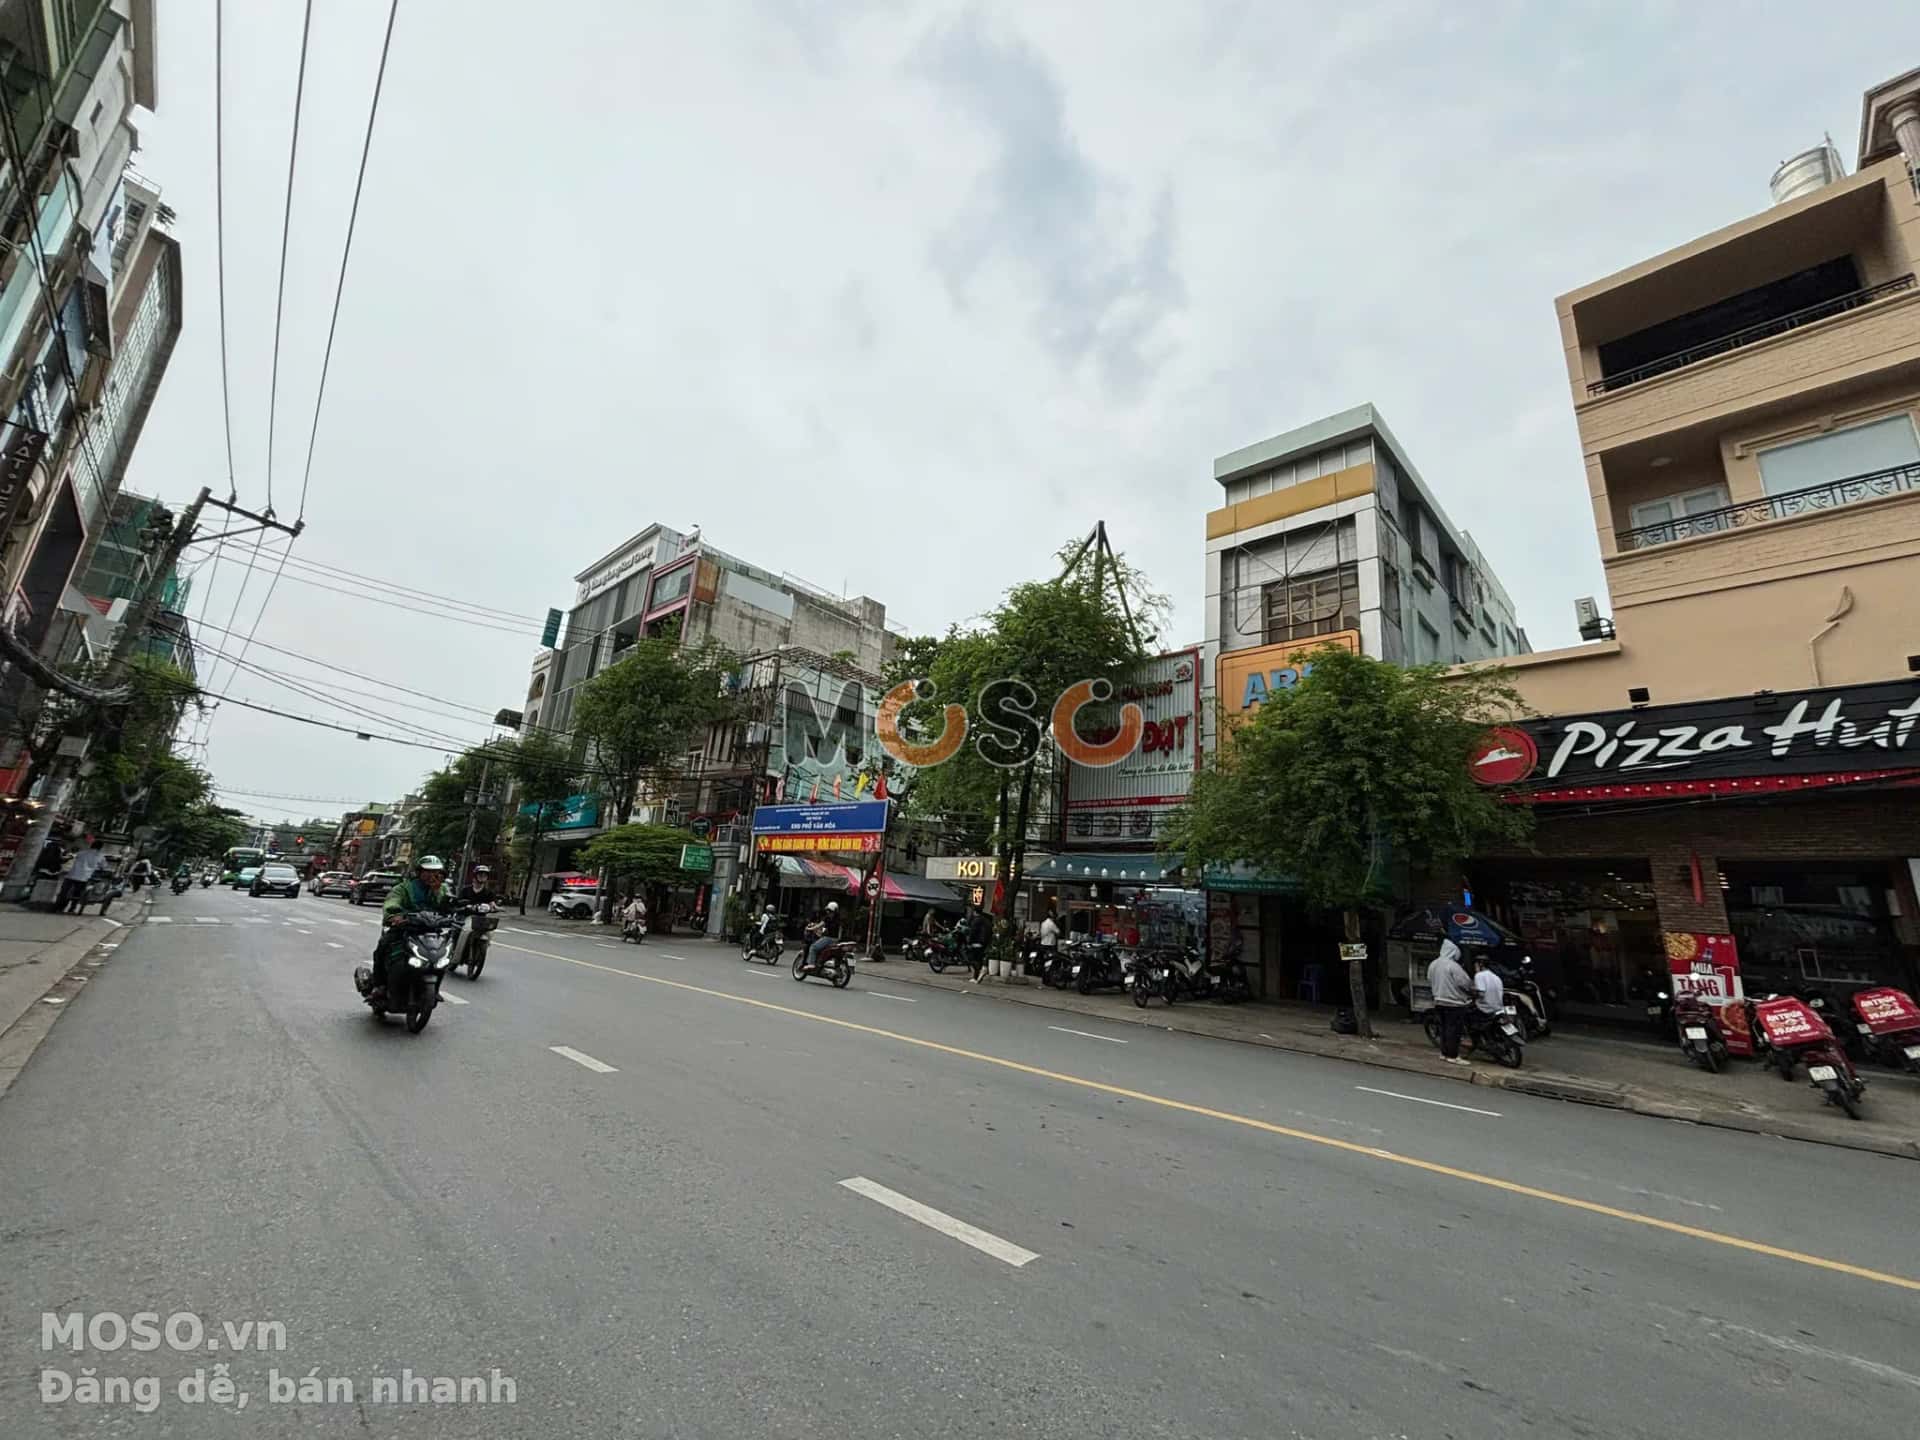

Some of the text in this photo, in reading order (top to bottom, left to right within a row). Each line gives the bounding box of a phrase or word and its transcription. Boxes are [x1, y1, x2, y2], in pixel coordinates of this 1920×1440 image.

[1242, 663, 1313, 709] AB
[1547, 697, 1920, 777] Pizza Hut
[957, 860, 984, 877] KOI
[1690, 961, 1713, 974] MUA
